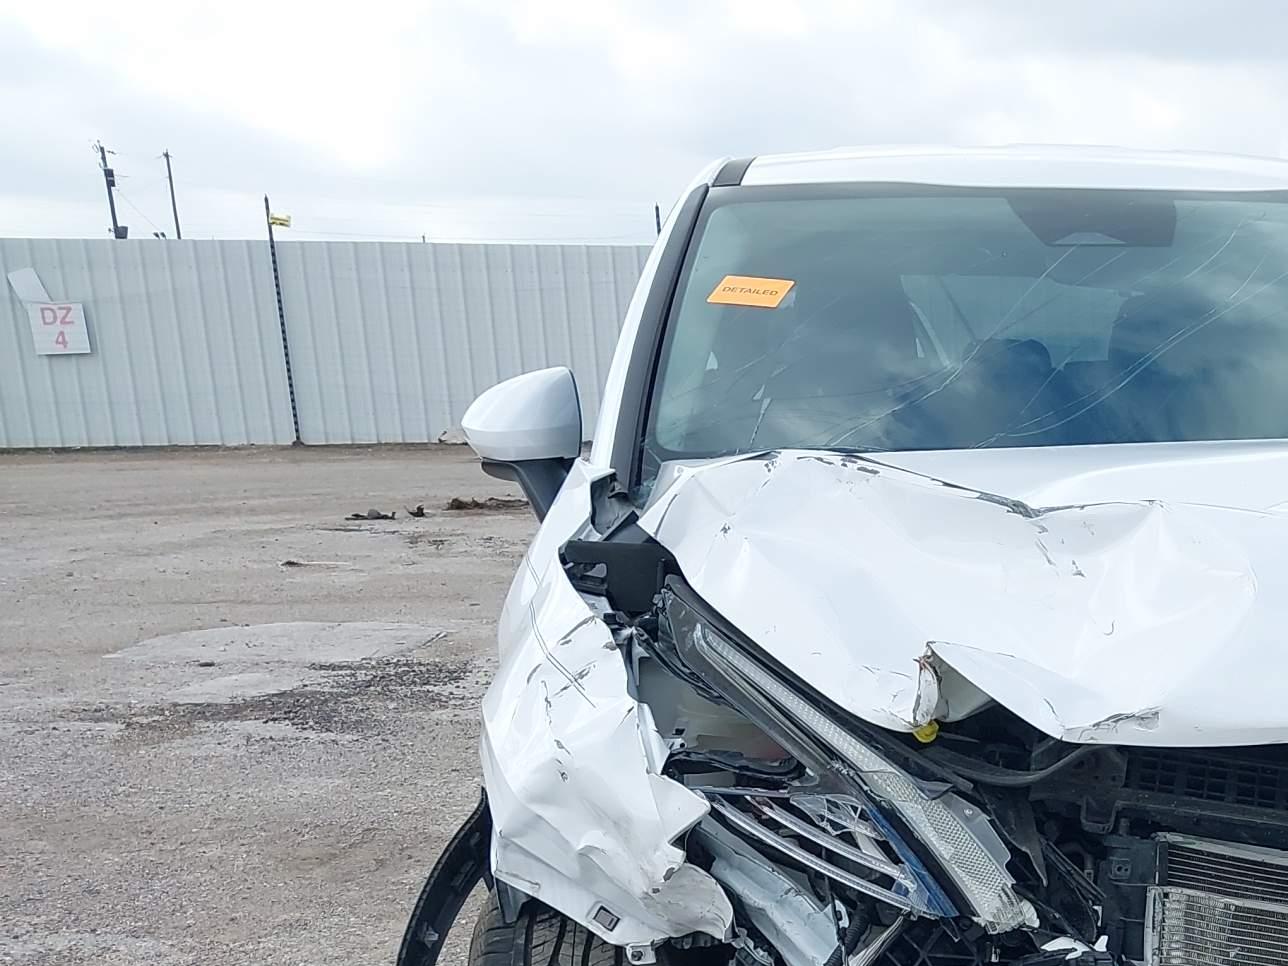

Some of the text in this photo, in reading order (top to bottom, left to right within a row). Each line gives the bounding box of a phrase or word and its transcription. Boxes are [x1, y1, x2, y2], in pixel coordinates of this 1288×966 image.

[721, 285, 779, 297] DETAILED
[40, 306, 75, 326] DZ
[55, 331, 68, 349] 4
